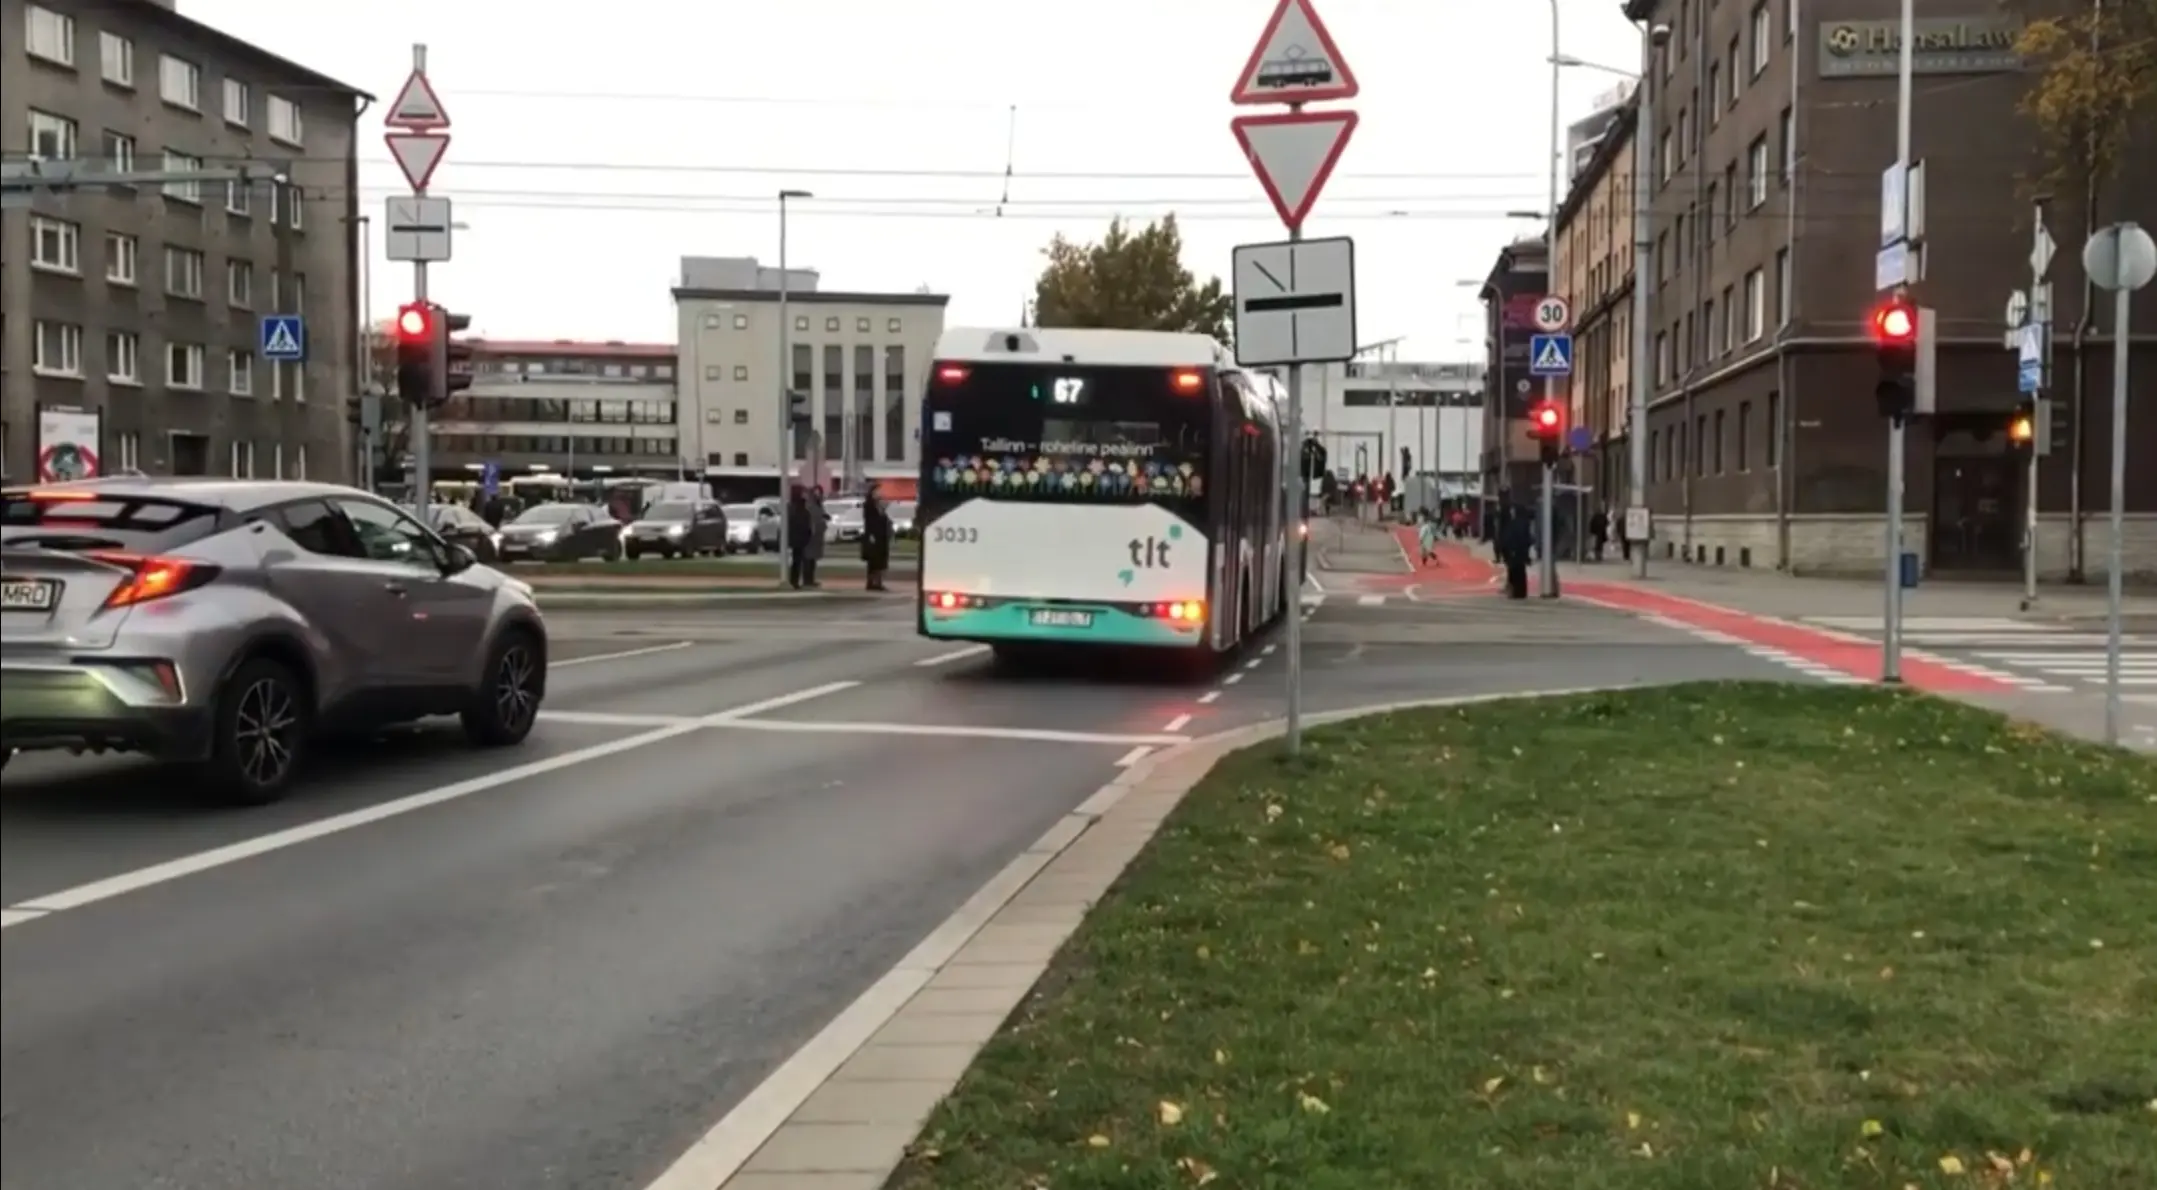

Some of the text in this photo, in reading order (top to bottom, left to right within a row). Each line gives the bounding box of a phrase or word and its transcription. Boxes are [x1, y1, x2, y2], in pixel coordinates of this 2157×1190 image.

[1541, 303, 1564, 323] 30
[1053, 378, 1084, 404] 67
[980, 437, 1026, 453] Tallinn
[1039, 440, 1098, 454] roheline
[1100, 442, 1155, 457] pealinn
[933, 526, 978, 543] 3033
[1128, 535, 1171, 568] tlt
